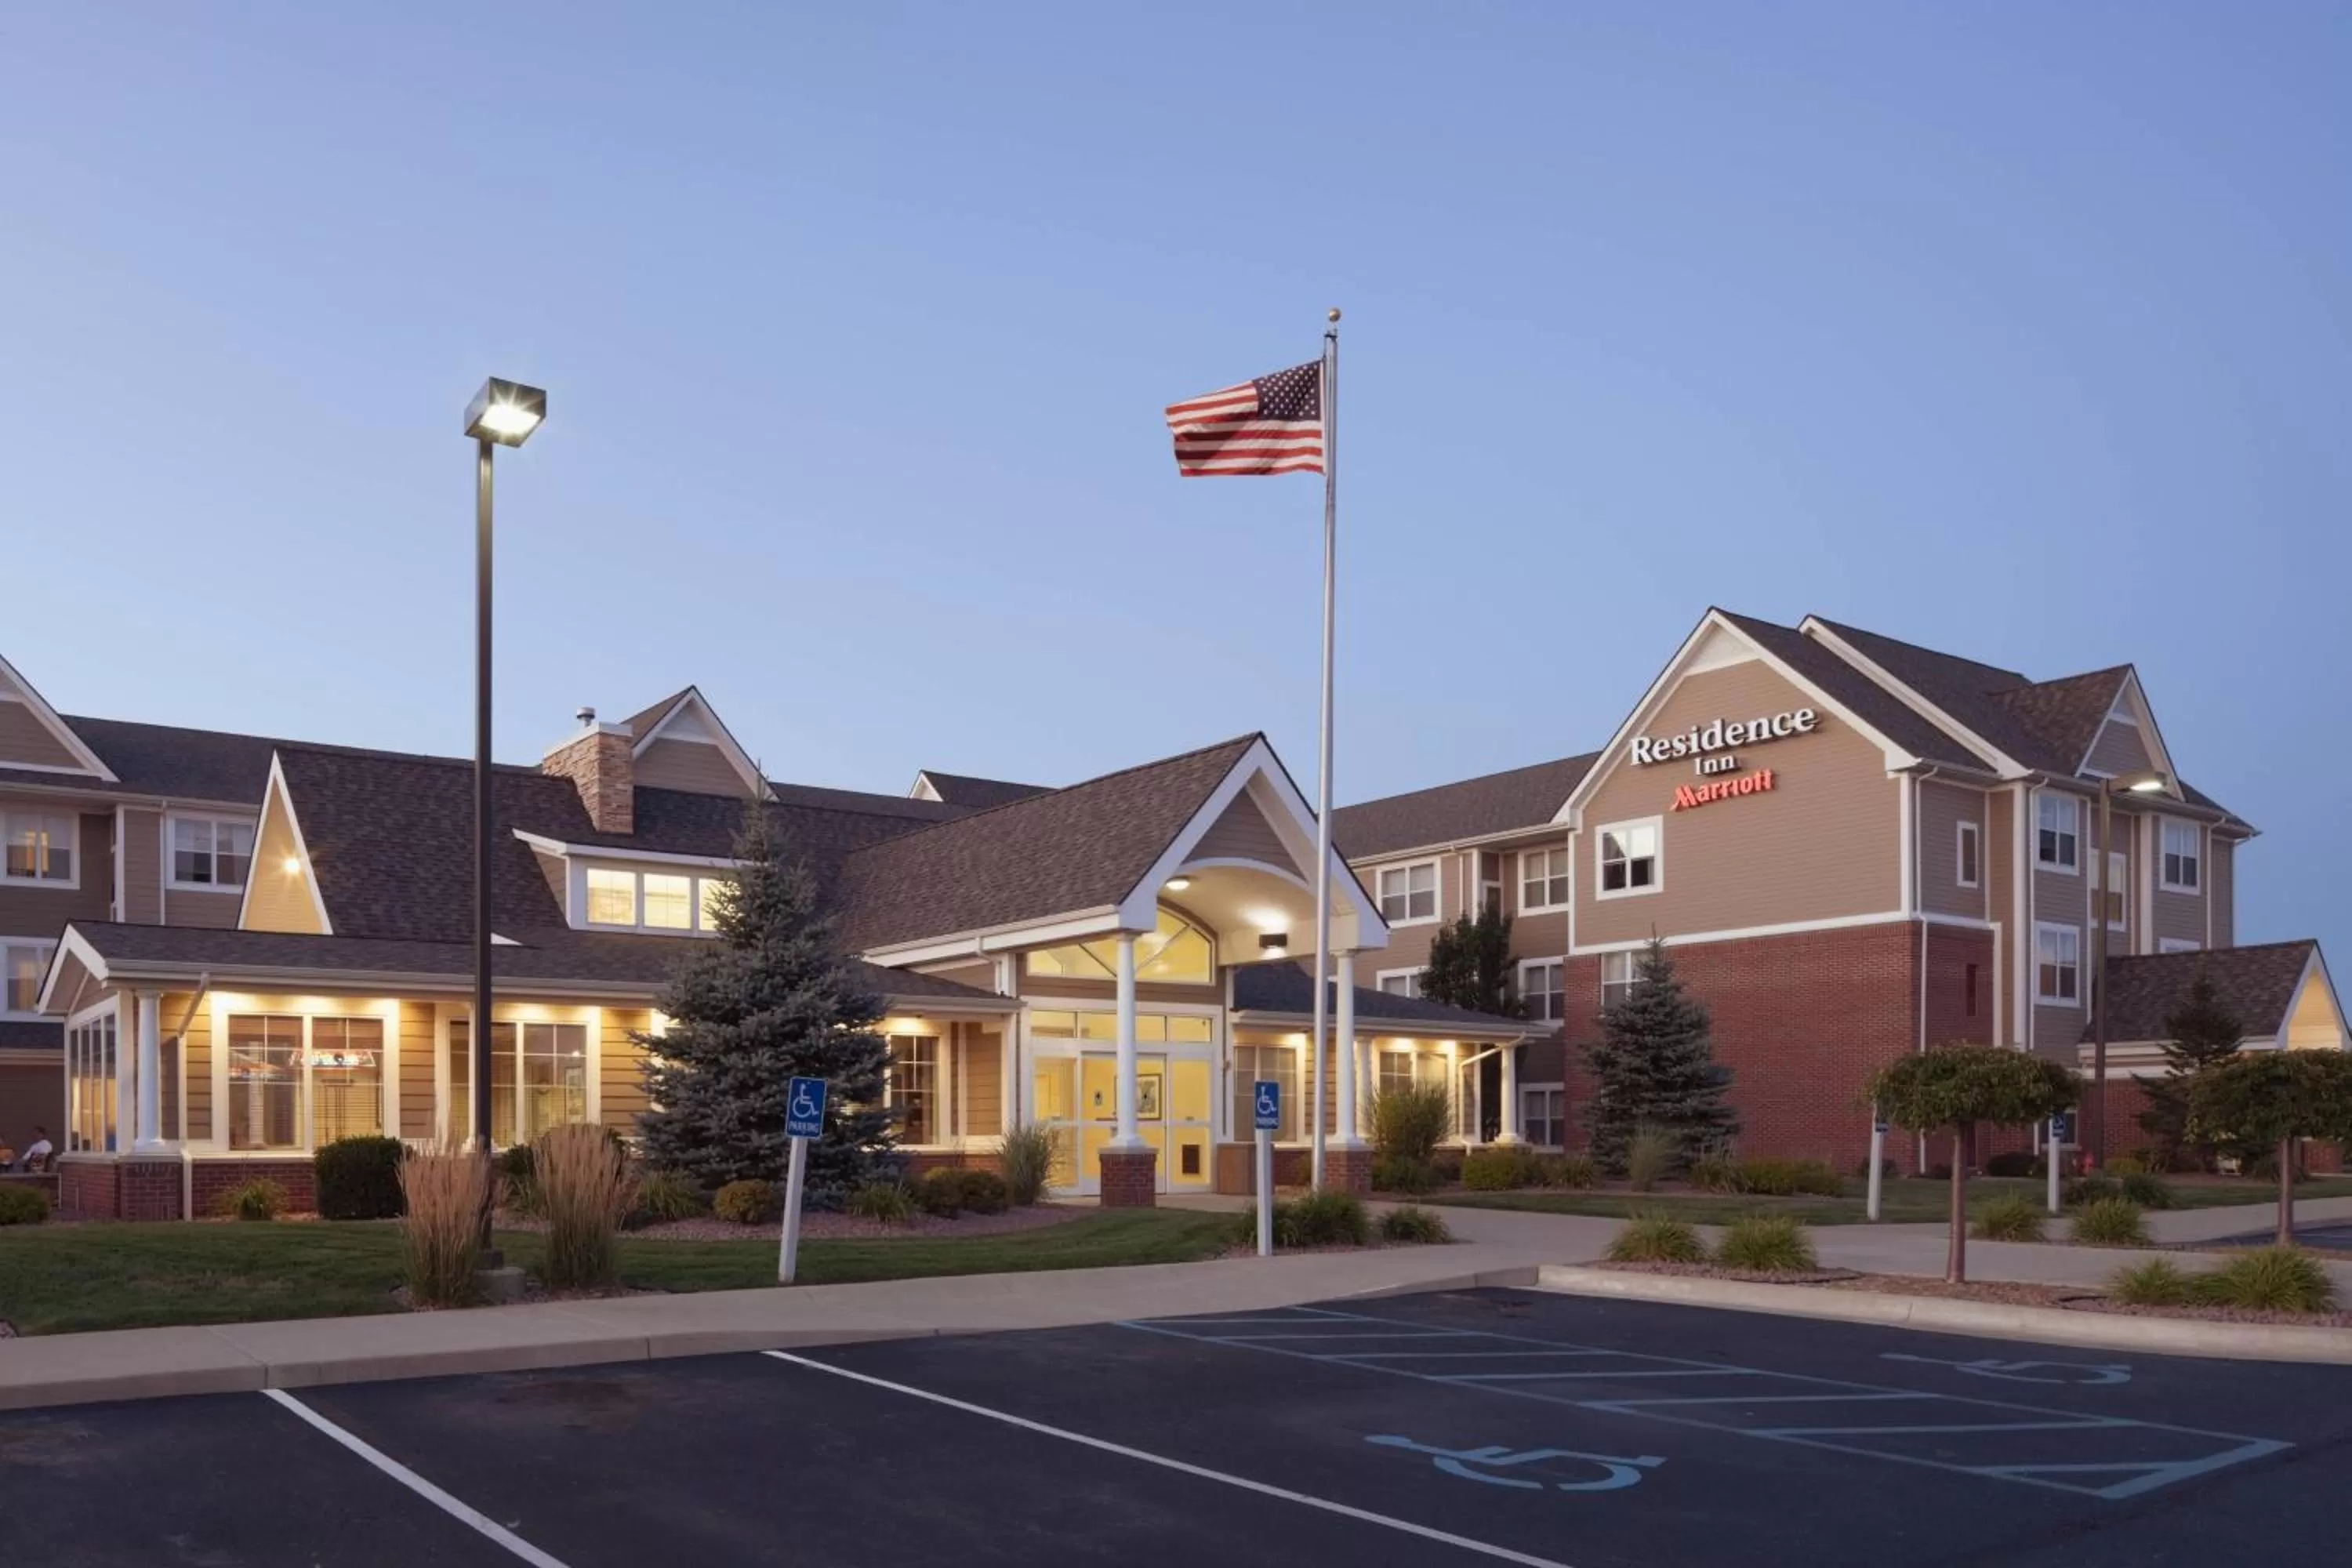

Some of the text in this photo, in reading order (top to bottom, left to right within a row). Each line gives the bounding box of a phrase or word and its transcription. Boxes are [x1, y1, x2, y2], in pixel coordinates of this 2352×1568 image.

[1630, 707, 1816, 766] Residence
[1694, 754, 1736, 775] Inn
[1670, 768, 1774, 811] Marriott
